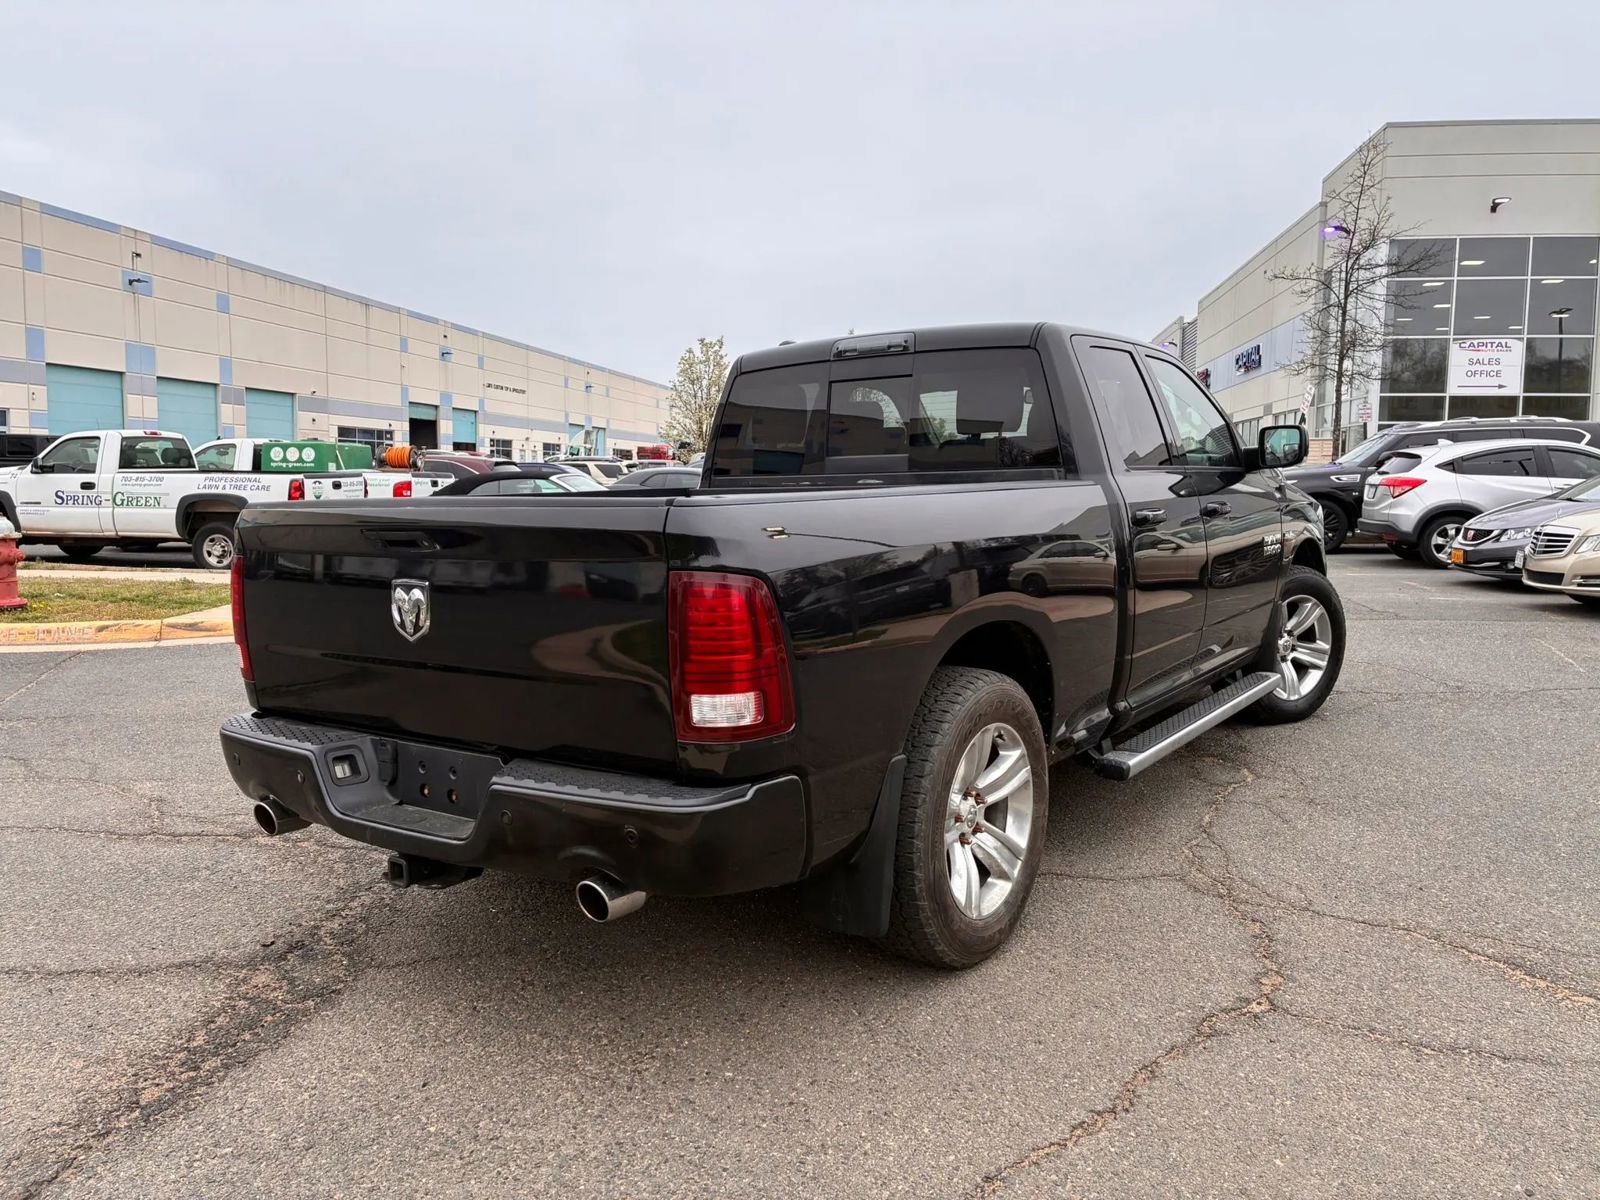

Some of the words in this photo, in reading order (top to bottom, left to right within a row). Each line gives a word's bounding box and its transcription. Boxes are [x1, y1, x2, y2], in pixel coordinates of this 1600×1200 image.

[1468, 358, 1500, 366] SALES
[1466, 370, 1502, 378] OFFICE
[121, 475, 165, 483] 703-815-3700
[204, 476, 262, 484] PROFESSIONAL
[249, 484, 271, 492] CARE
